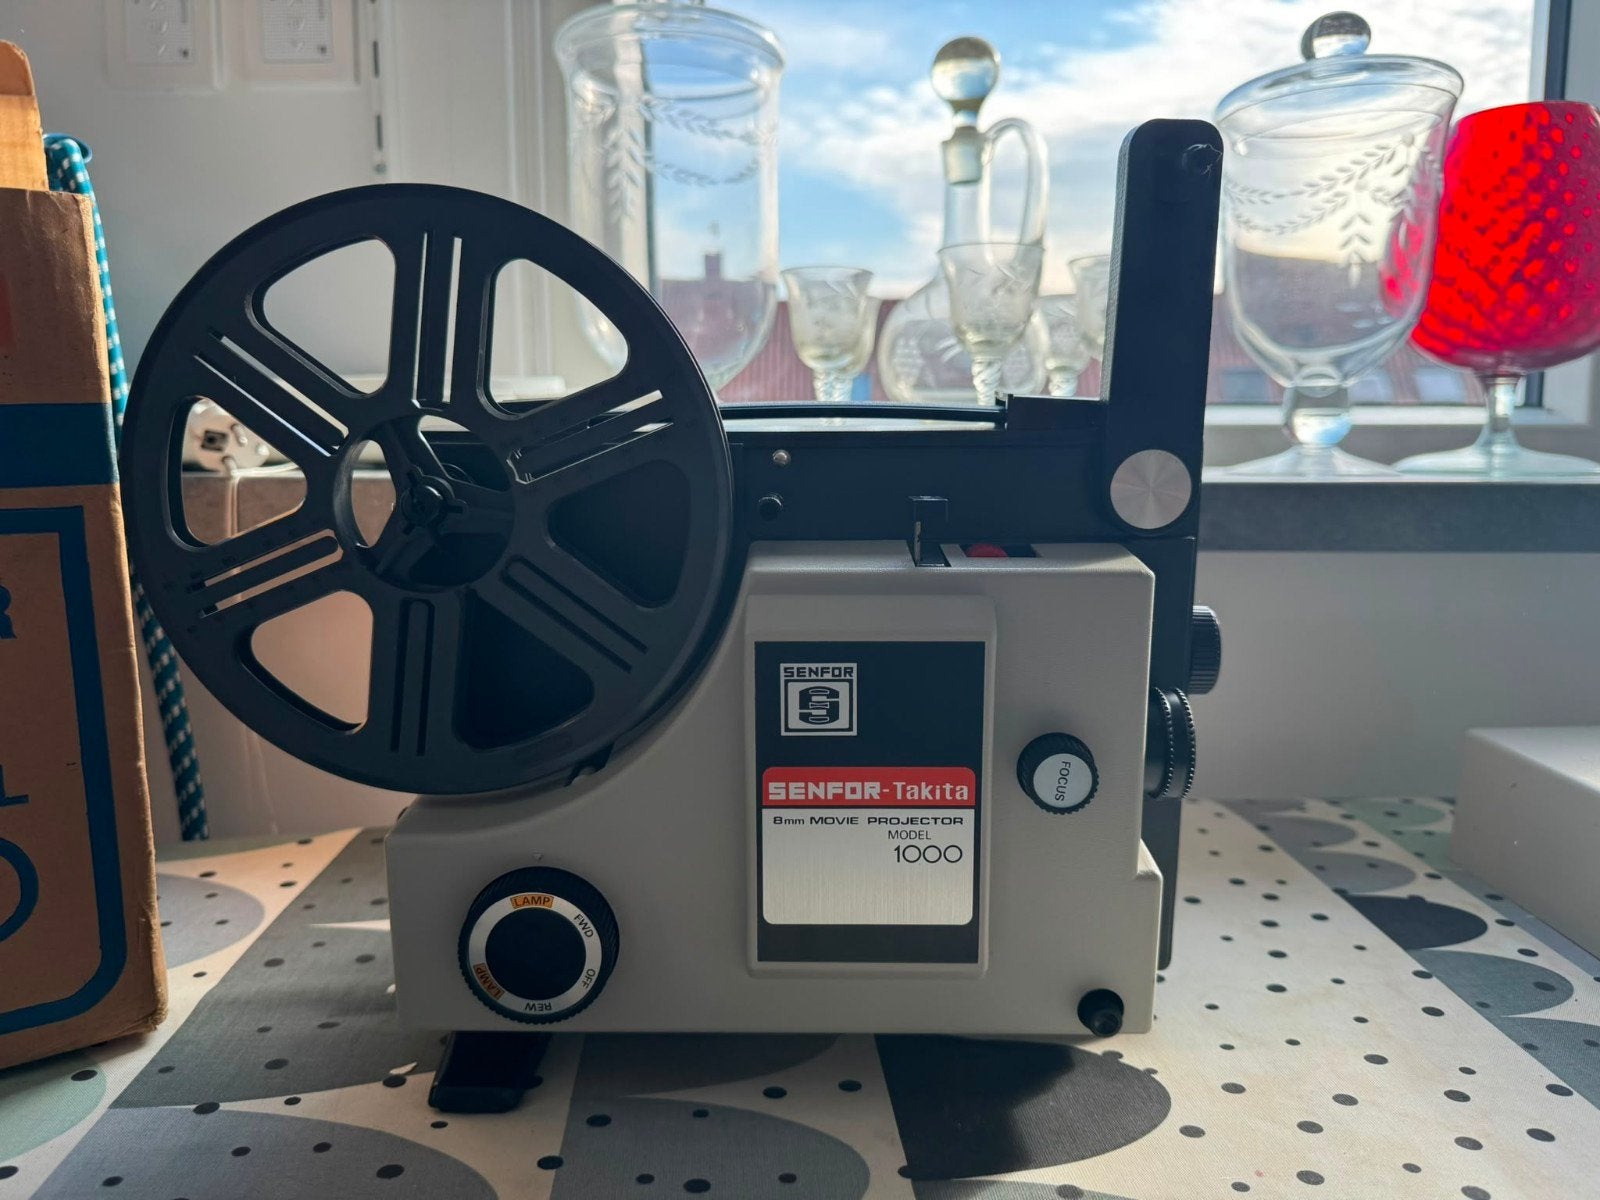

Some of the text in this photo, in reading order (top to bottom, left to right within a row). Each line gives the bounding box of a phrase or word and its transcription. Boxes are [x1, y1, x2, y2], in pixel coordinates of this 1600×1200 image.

[783, 666, 854, 678] SENFOR
[1054, 761, 1071, 801] FOCUS
[768, 781, 969, 801] SENFOR-Takita
[773, 816, 964, 826] 8mm MOVIE PROJECTOR
[888, 830, 932, 840] MODEL
[894, 845, 963, 864] 1000
[514, 896, 551, 907] LAMP
[574, 913, 594, 938] FWD
[476, 966, 504, 998] LAMP
[582, 968, 596, 989] OFF
[524, 1002, 552, 1012] REW
